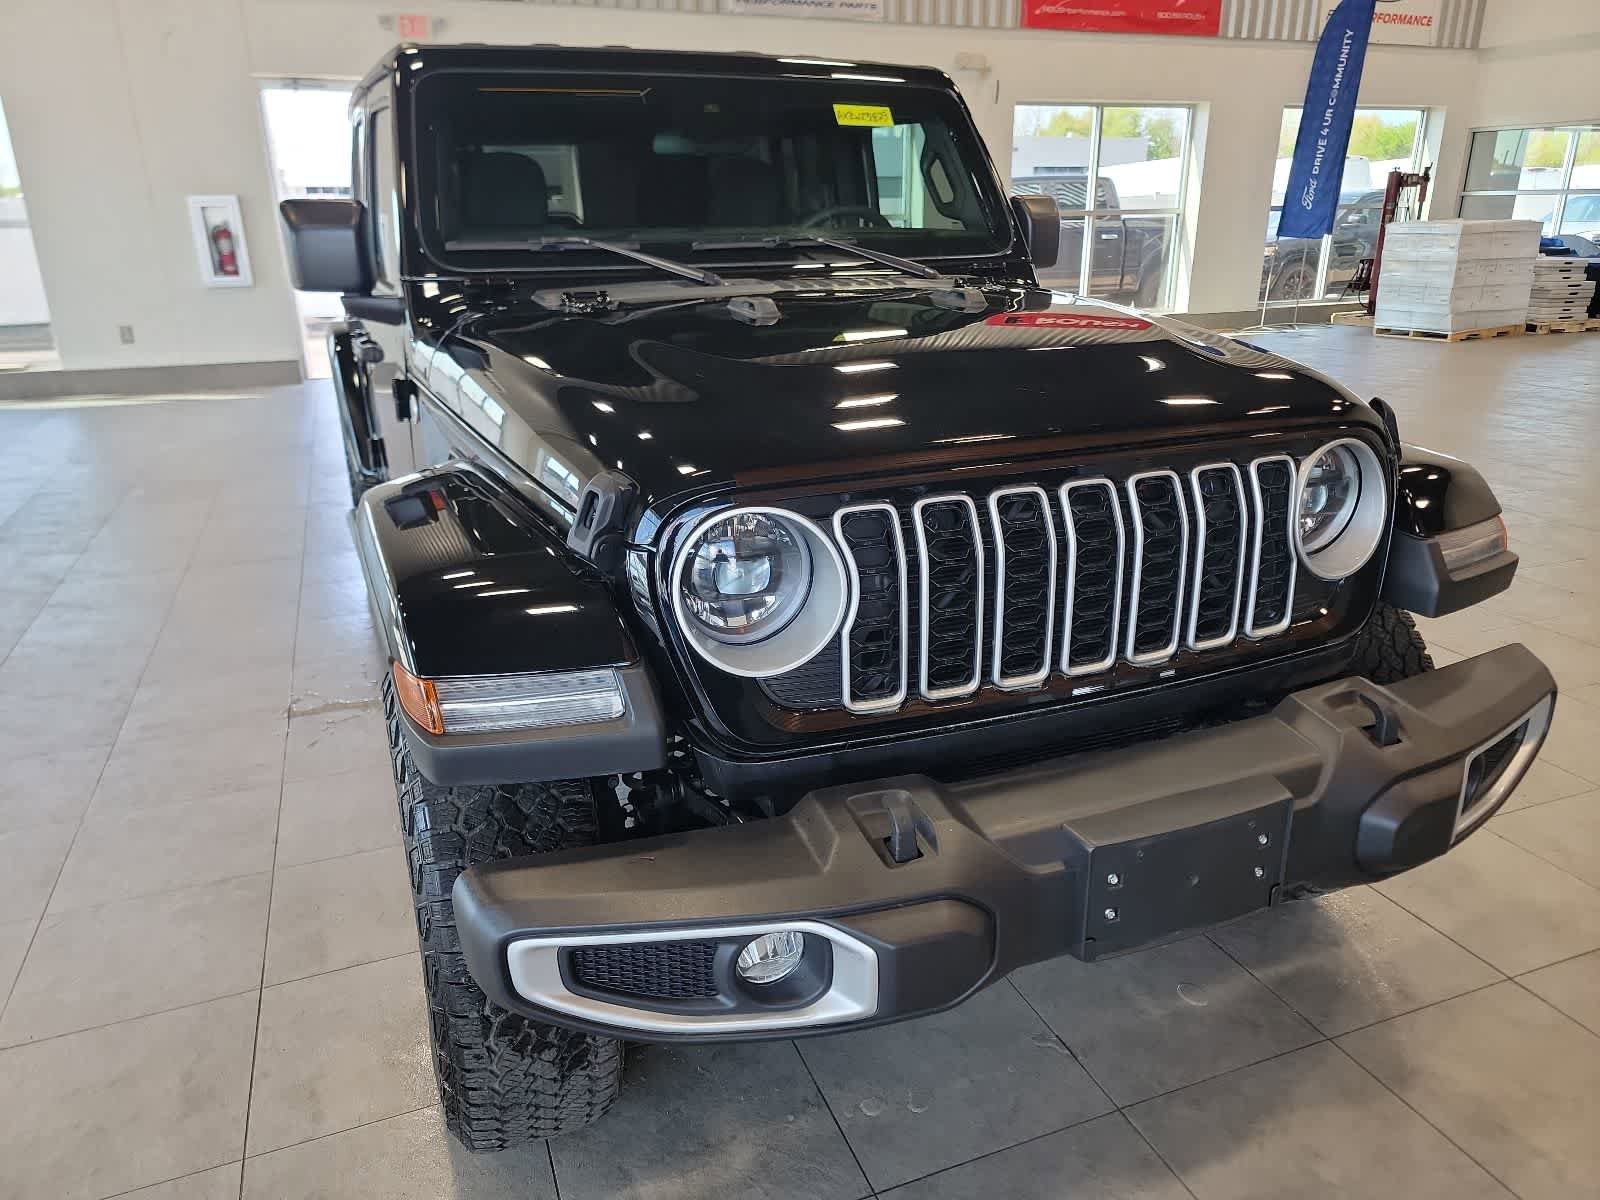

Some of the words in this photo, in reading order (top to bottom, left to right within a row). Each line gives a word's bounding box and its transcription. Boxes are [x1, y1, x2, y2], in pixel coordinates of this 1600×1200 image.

[1373, 12, 1432, 26] RFORMANCE
[1328, 29, 1354, 106] COMMUNITY
[1322, 108, 1334, 127] UR
[1320, 127, 1329, 137] 4
[1311, 138, 1328, 175] DRIVE
[1301, 178, 1318, 210] Ford
